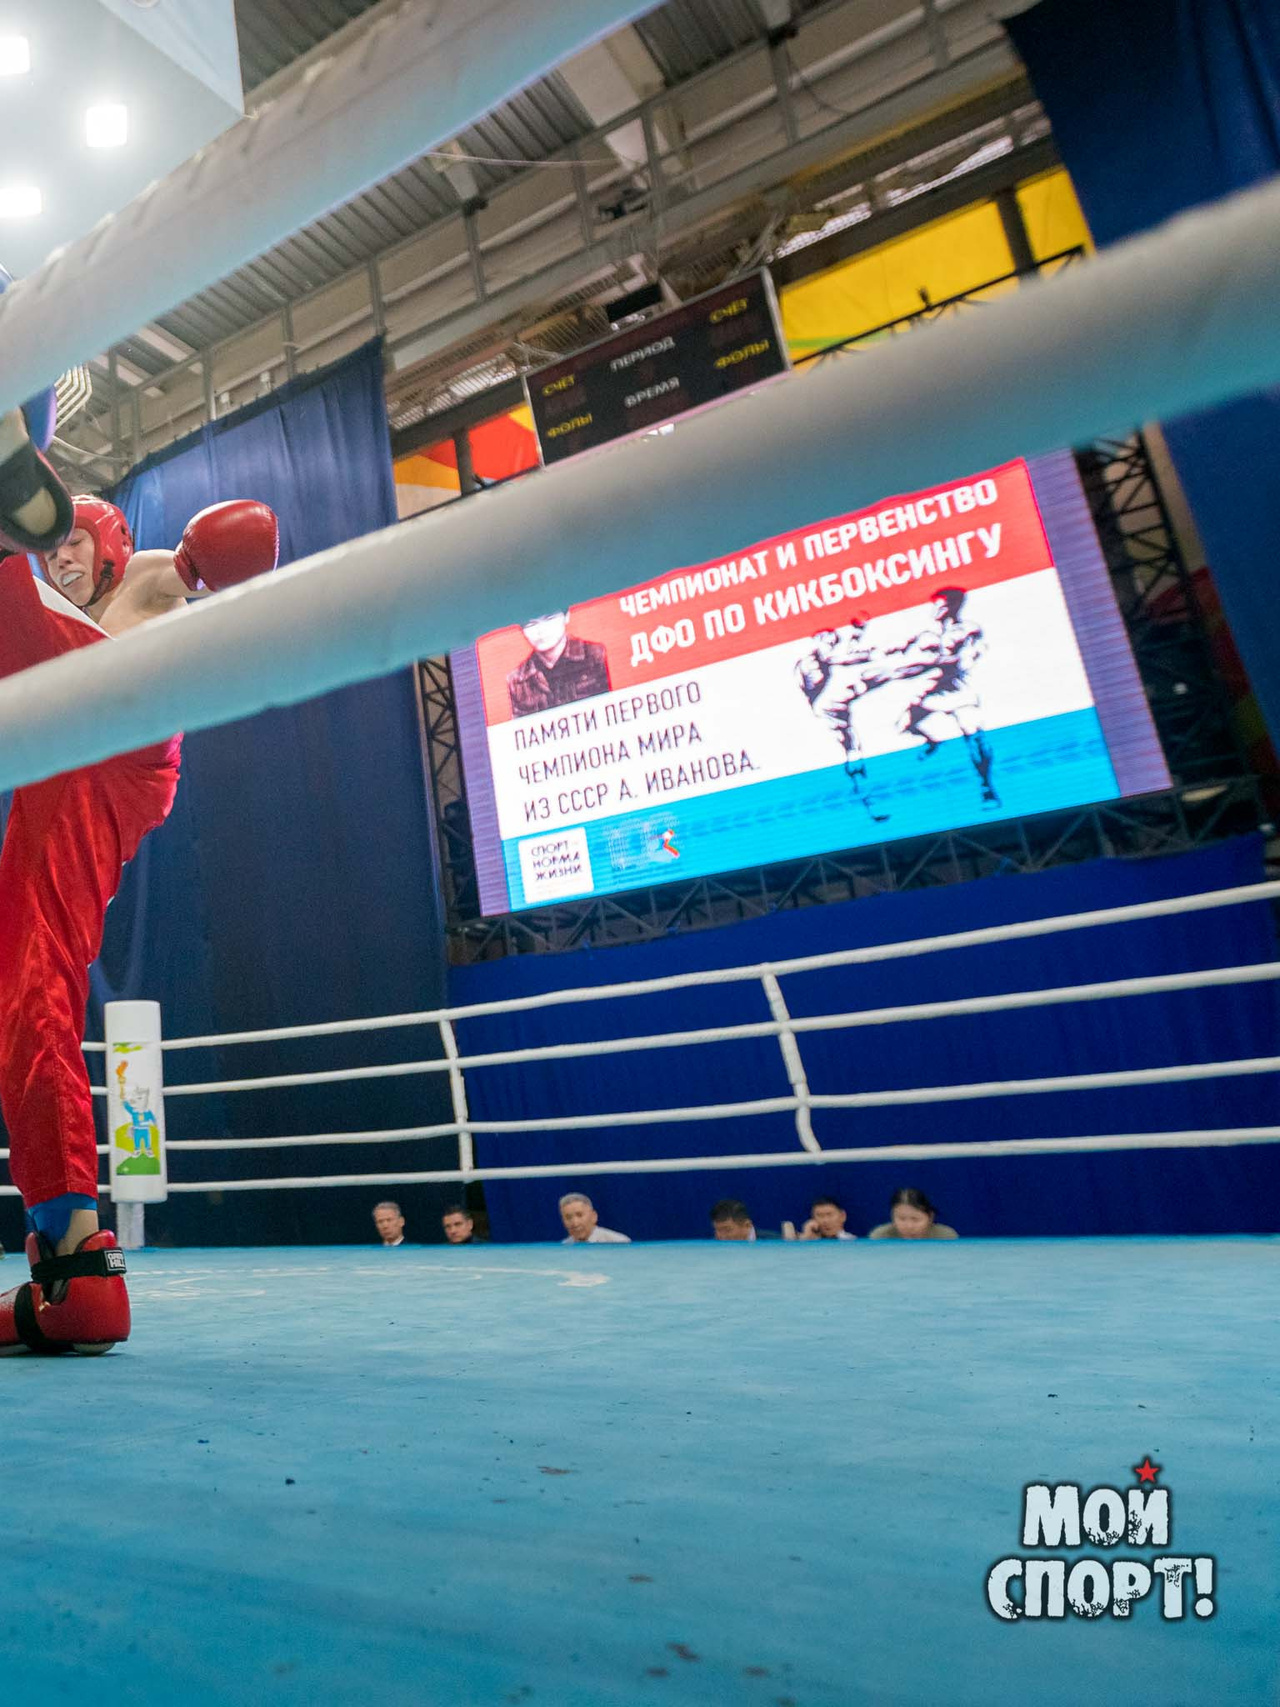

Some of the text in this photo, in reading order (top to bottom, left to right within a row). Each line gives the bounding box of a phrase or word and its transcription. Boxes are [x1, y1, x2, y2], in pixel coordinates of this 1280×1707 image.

[609, 336, 675, 371] ПЕРИОД
[714, 339, 769, 369] ФОЛЫ
[624, 376, 680, 408] ВРЕМЯ
[547, 413, 593, 438] ФОЛЫ
[620, 478, 998, 618] ЧЕМПИОНАТ И ПЕРВЕНСТВО
[630, 522, 1003, 668] ДФО ПО КИКБОКСИНГУ
[514, 681, 701, 751] ПАМЯТИ ПЕРВОГО
[519, 721, 702, 785] ЧЕМПИОНА МИРА
[524, 748, 761, 823] ИЗ СССР А. ИВАНОВА.
[531, 840, 569, 856] СПОРТ
[533, 851, 580, 868] НОРМА
[536, 864, 582, 881] ЖИЗНИ
